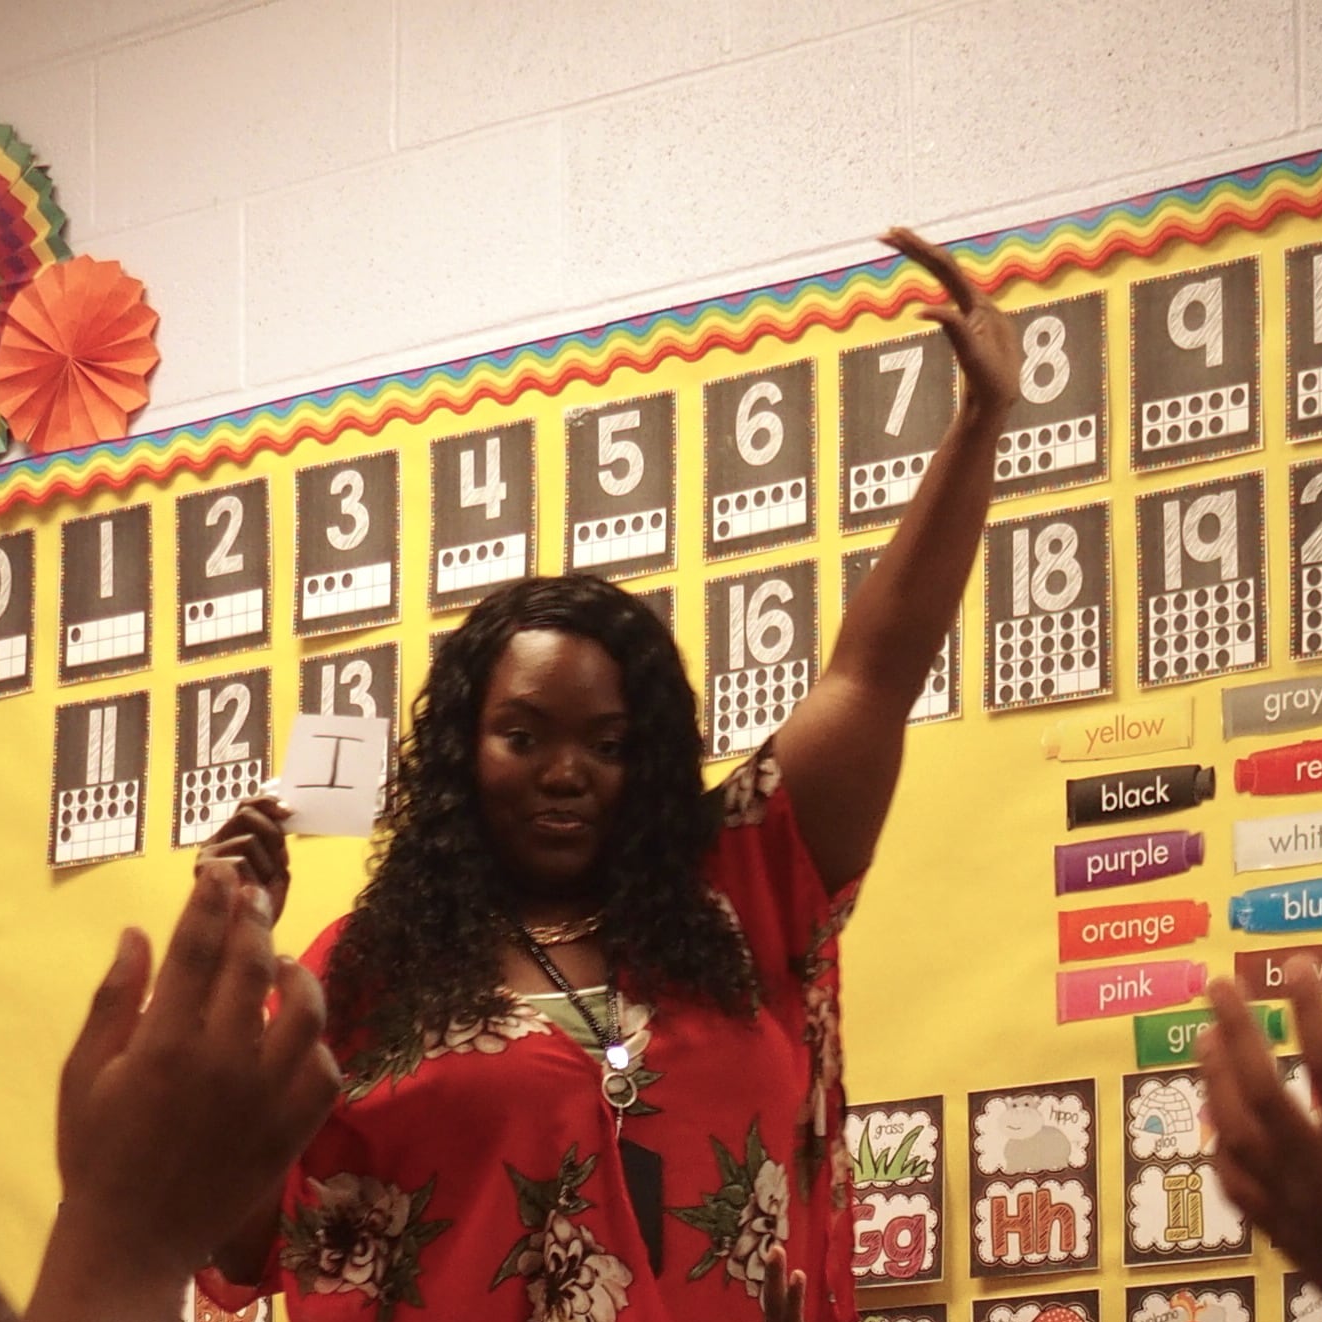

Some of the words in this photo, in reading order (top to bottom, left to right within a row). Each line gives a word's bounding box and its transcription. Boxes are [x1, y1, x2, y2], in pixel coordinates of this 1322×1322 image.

[1018, 315, 1071, 404] 8
[1165, 276, 1225, 368] 9
[734, 381, 785, 467] 6
[878, 346, 924, 437] 7
[459, 437, 507, 520] 4
[596, 409, 646, 495] 5
[204, 496, 245, 578] 2
[326, 469, 371, 551] 3
[1161, 490, 1239, 591] 19
[99, 520, 114, 598] 1
[1010, 521, 1085, 617] 18
[727, 578, 795, 672] 16
[196, 681, 253, 768] 12
[321, 660, 377, 719] 13
[85, 706, 118, 786] 11
[296, 734, 365, 789] I
[1084, 715, 1164, 753] yellow
[1101, 776, 1170, 811] black
[1087, 839, 1169, 881] purple
[1082, 914, 1175, 945] orange
[1100, 971, 1152, 1010] pink
[1168, 1020, 1210, 1053] gre
[875, 1122, 905, 1140] grass
[1049, 1106, 1078, 1125] hippo
[1154, 1136, 1177, 1153] igloo
[853, 1204, 926, 1278] Gg
[991, 1189, 1076, 1257] Hh
[1163, 1172, 1203, 1243] Ii
